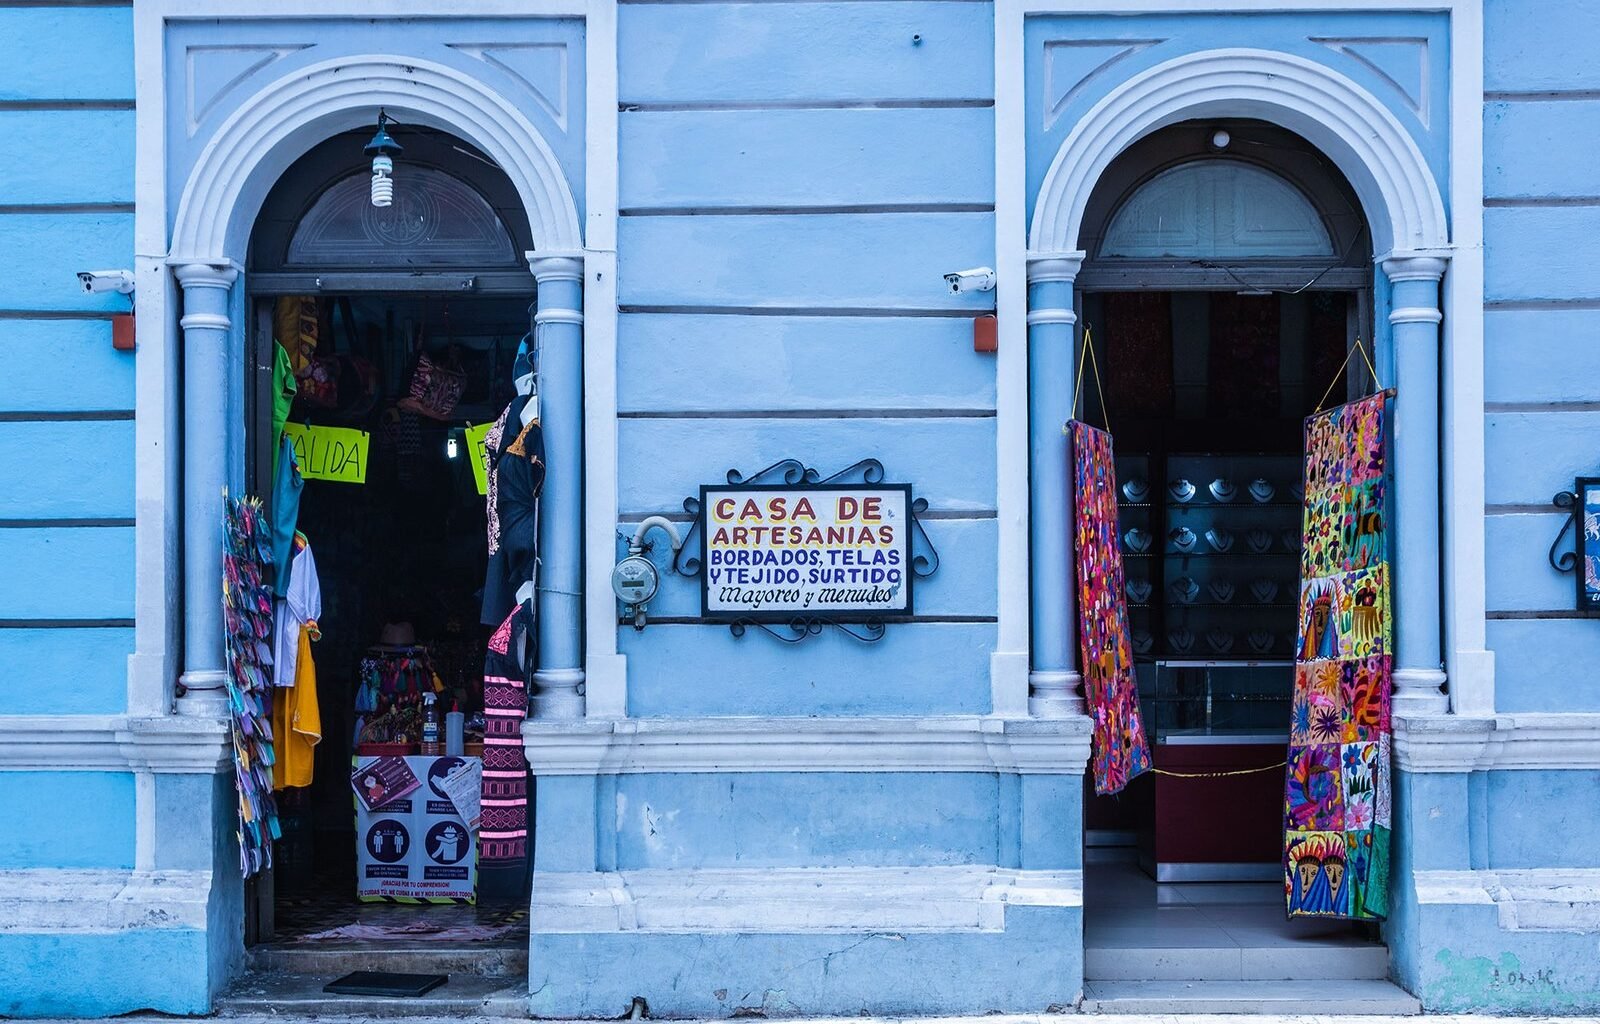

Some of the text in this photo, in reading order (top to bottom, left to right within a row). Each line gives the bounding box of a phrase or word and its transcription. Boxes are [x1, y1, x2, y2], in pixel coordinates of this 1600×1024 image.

[287, 432, 360, 478] ALIDA
[713, 496, 882, 523] CASA DE
[711, 526, 894, 547] ARTESANIAS
[711, 549, 900, 568] BORDADOS, TELAS
[808, 568, 901, 584] SURTIDO
[719, 585, 892, 608] Mayoreo y menudeo
